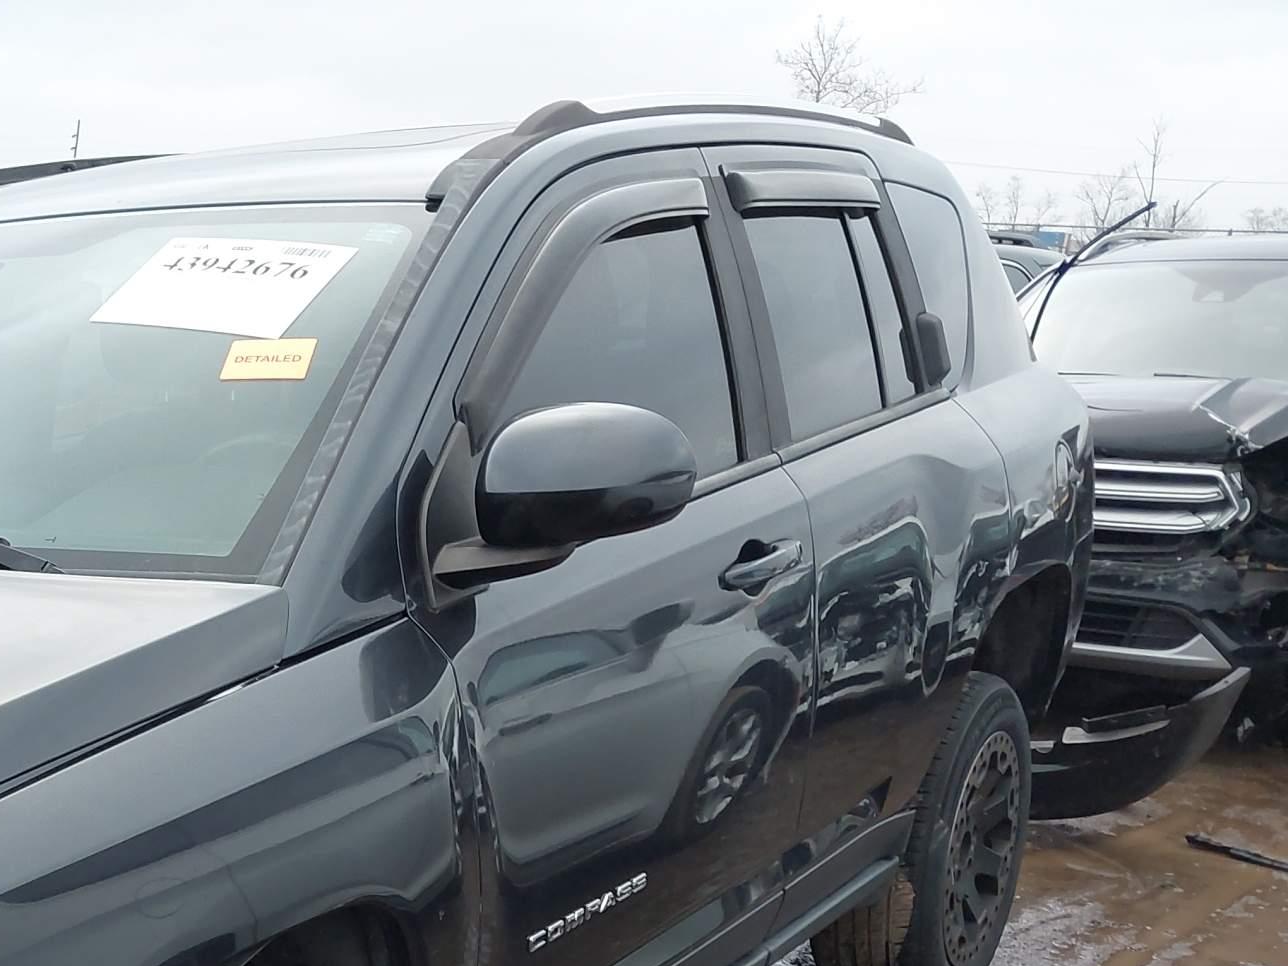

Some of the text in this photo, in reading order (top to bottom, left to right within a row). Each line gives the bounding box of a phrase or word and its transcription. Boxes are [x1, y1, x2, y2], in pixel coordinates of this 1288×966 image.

[162, 255, 310, 281] 43942676
[233, 353, 303, 365] DETAILED
[526, 871, 648, 953] COMPASS
